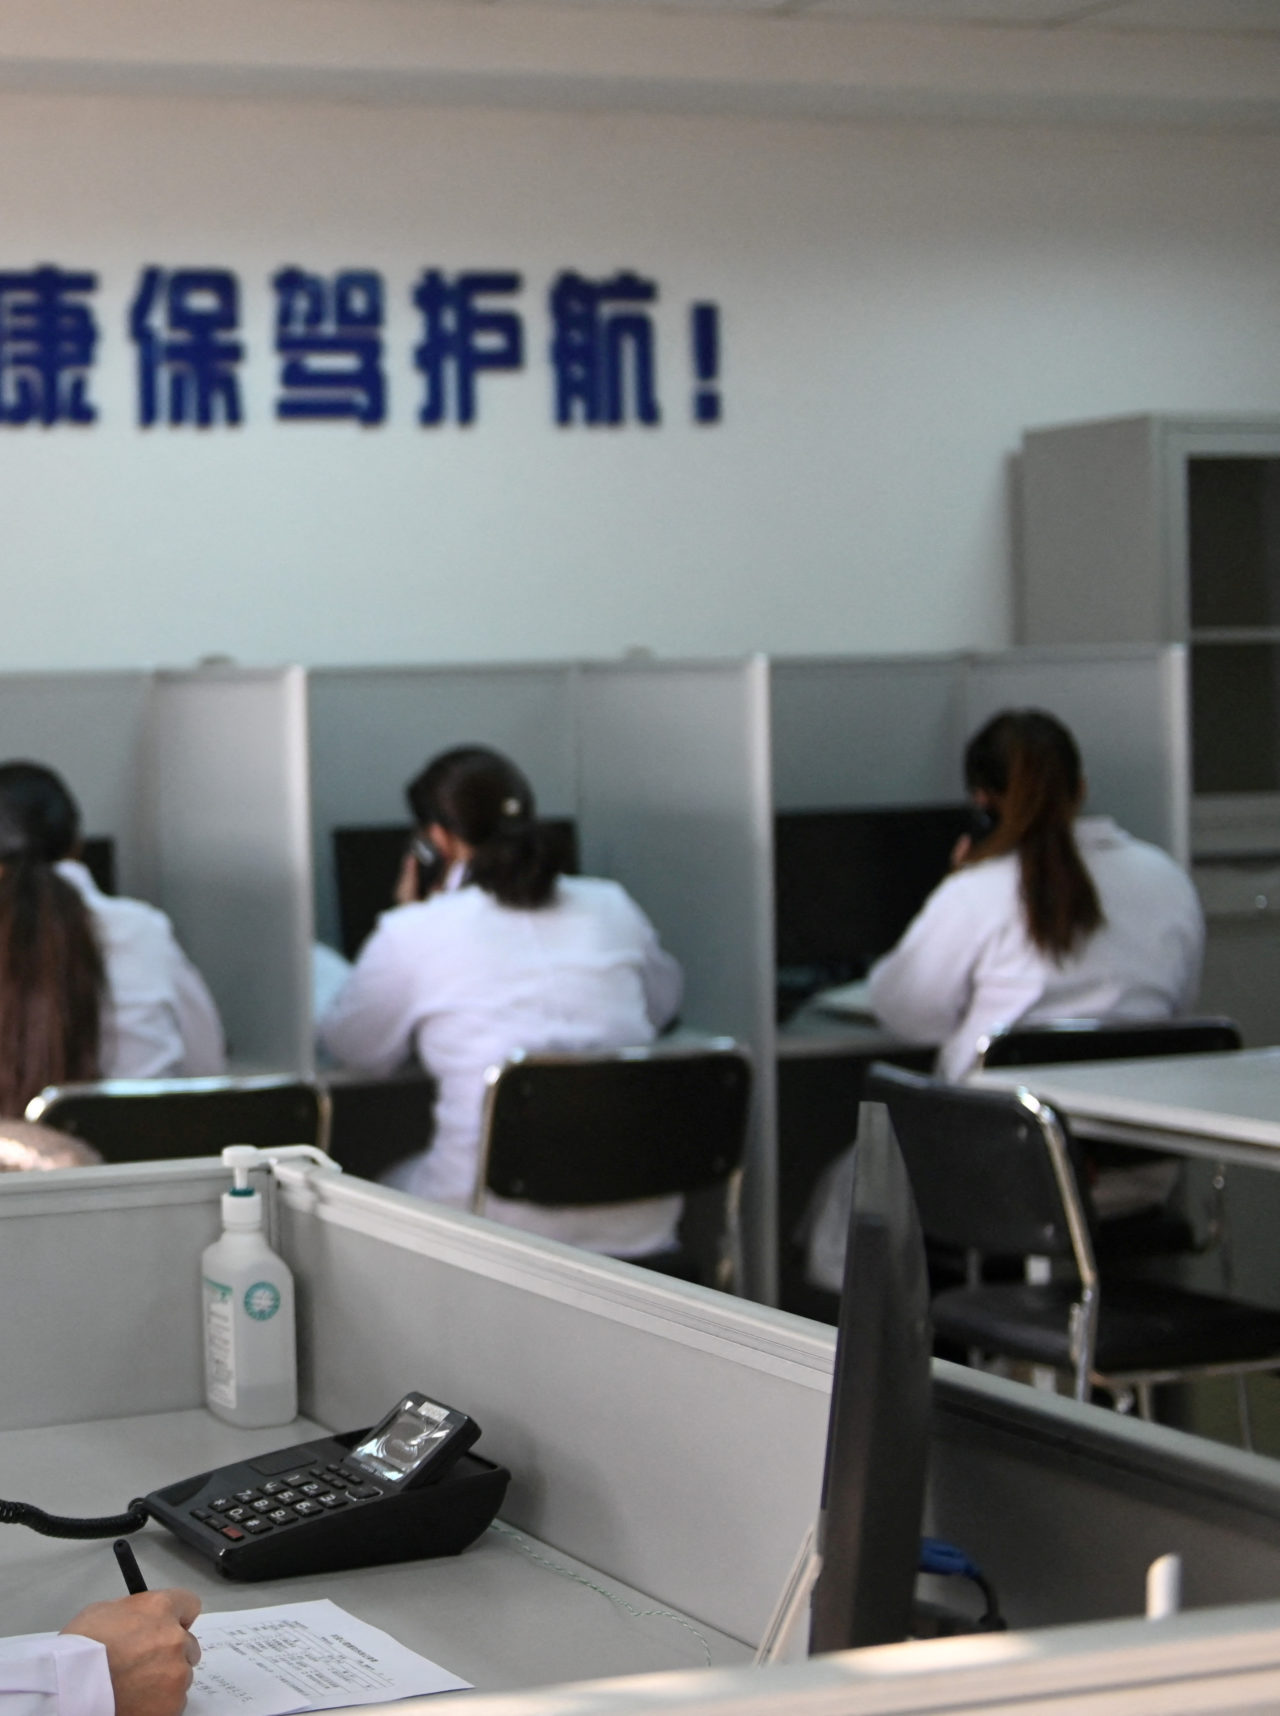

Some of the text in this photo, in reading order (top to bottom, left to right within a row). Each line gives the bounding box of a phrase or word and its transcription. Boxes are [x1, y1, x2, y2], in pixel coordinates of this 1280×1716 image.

[278, 1491, 294, 1500] 5
[296, 1502, 311, 1511] 6
[303, 1483, 319, 1492] 2
[320, 1494, 336, 1502] 3
[254, 1499, 269, 1508] 8
[270, 1509, 285, 1518] 9
